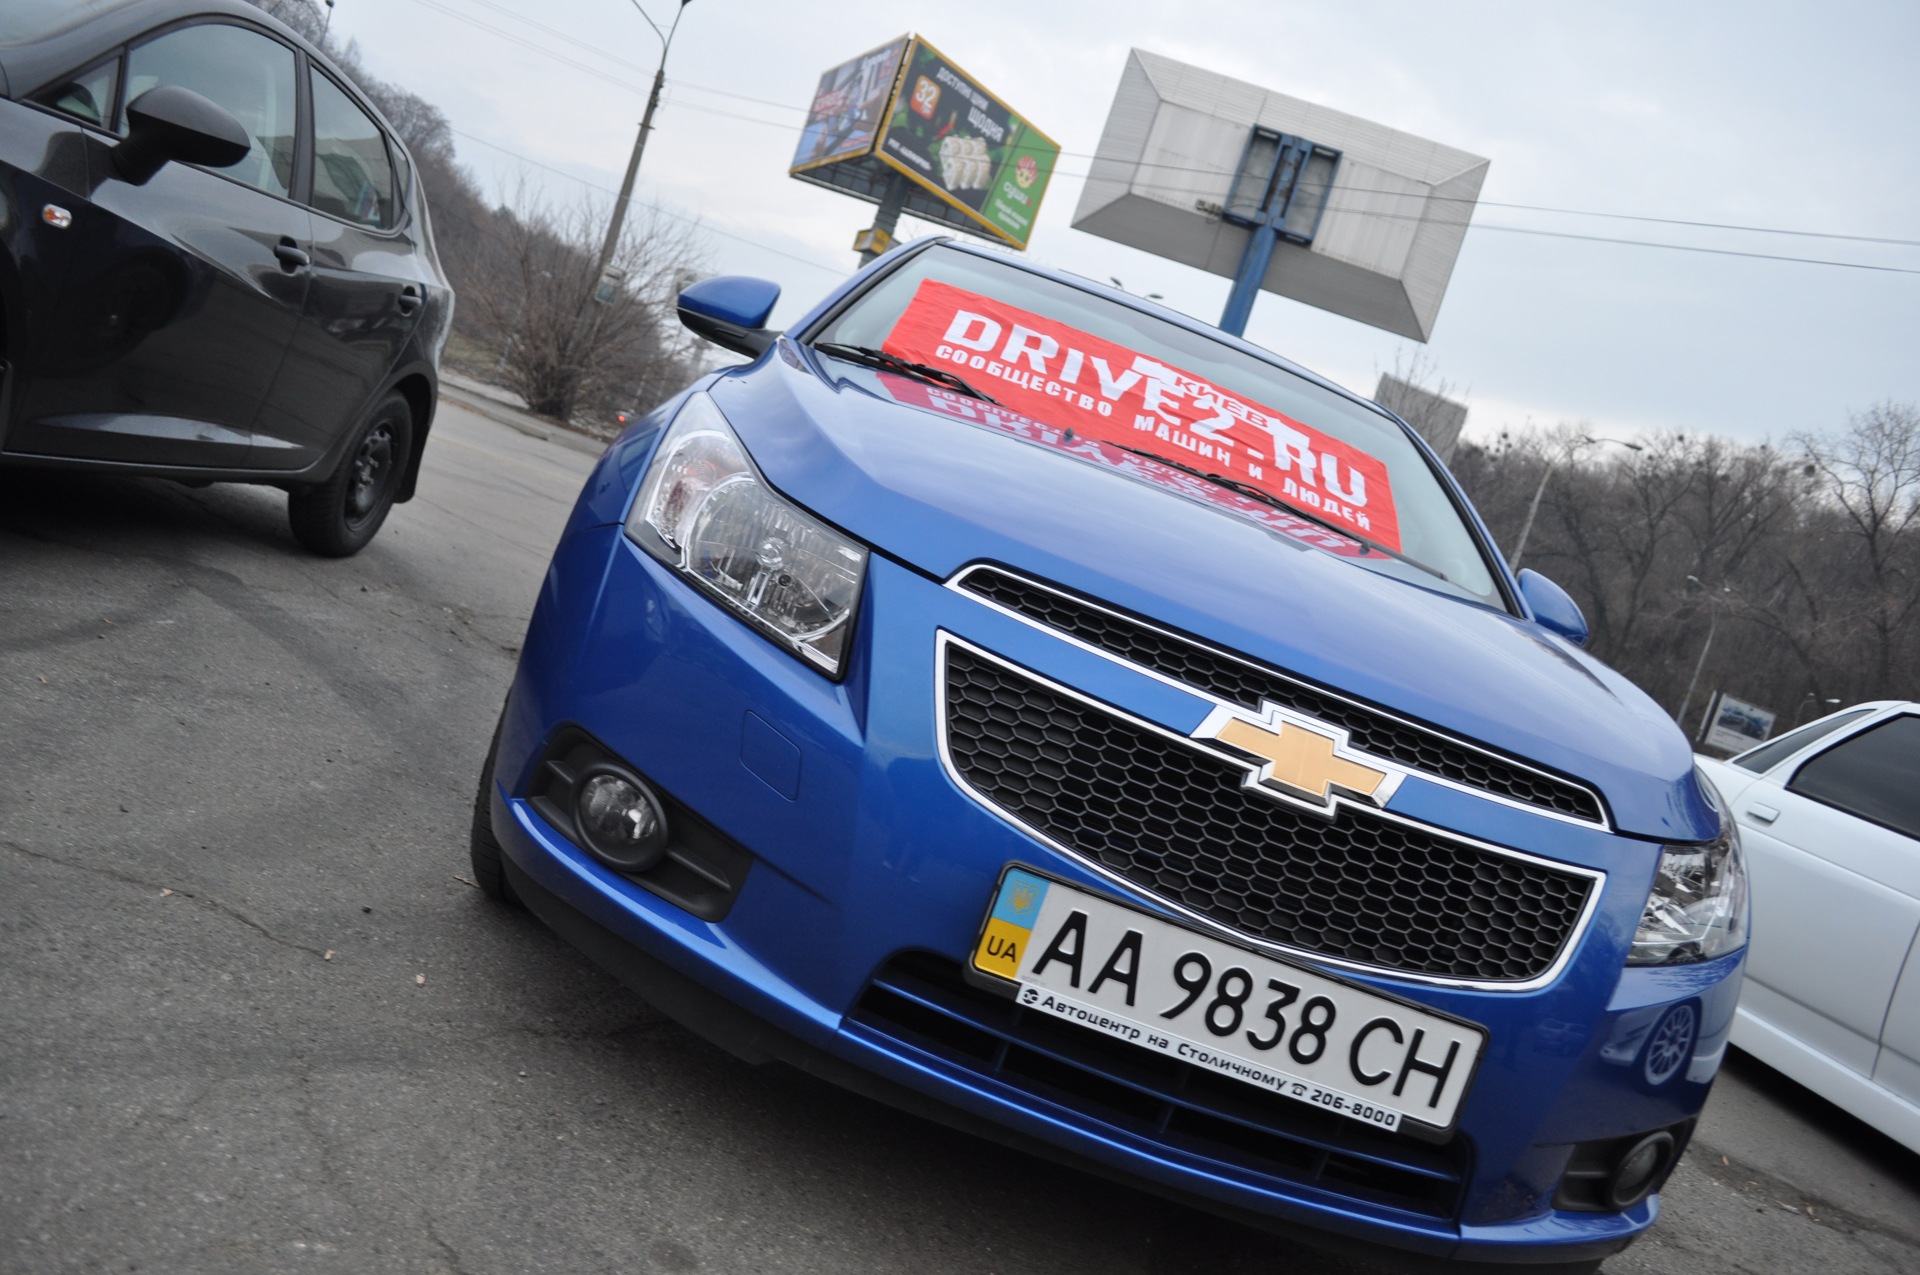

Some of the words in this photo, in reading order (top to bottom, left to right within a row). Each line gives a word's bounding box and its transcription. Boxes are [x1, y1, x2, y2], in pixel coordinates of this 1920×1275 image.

[915, 80, 937, 102] 32
[935, 345, 1113, 417] СООБЩЕСТВО
[1133, 414, 1231, 467] МАШИН
[1248, 463, 1263, 481] И
[1282, 478, 1371, 531] ЛЮДЕЙ
[1169, 374, 1270, 427] КИЕВ
[986, 935, 1017, 963] UA
[1031, 910, 1143, 1007] AA
[1159, 951, 1337, 1065] 9838
[1349, 1016, 1461, 1108] CH
[1041, 995, 1141, 1041] Автоцентр
[1146, 1033, 1169, 1049] на
[1177, 1042, 1287, 1091] Столичному
[1310, 1088, 1397, 1128] 206-8000
